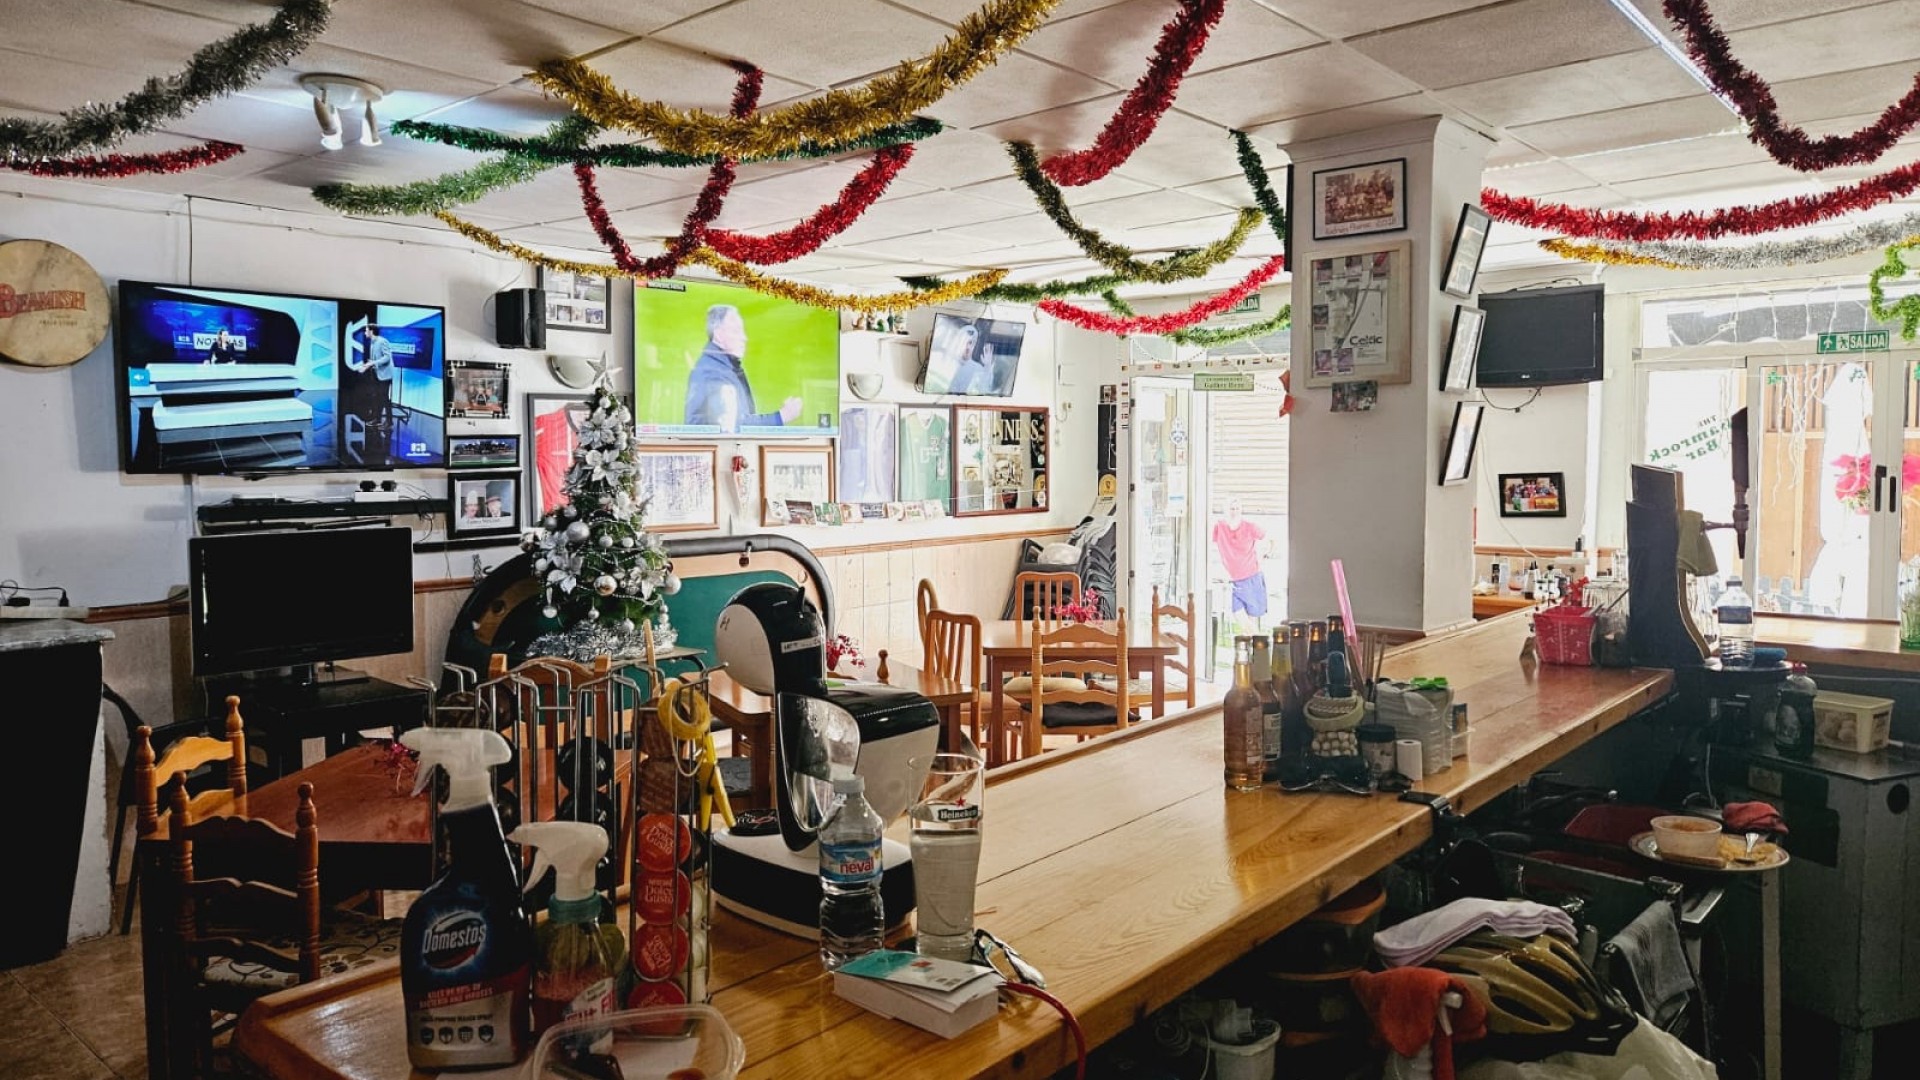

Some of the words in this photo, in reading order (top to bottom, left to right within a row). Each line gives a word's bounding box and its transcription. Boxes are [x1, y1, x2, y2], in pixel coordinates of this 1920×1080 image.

[1350, 335, 1383, 346] Celtic
[1850, 334, 1885, 349] SALIDA
[840, 859, 874, 874] neval
[422, 924, 487, 953] Domestos
